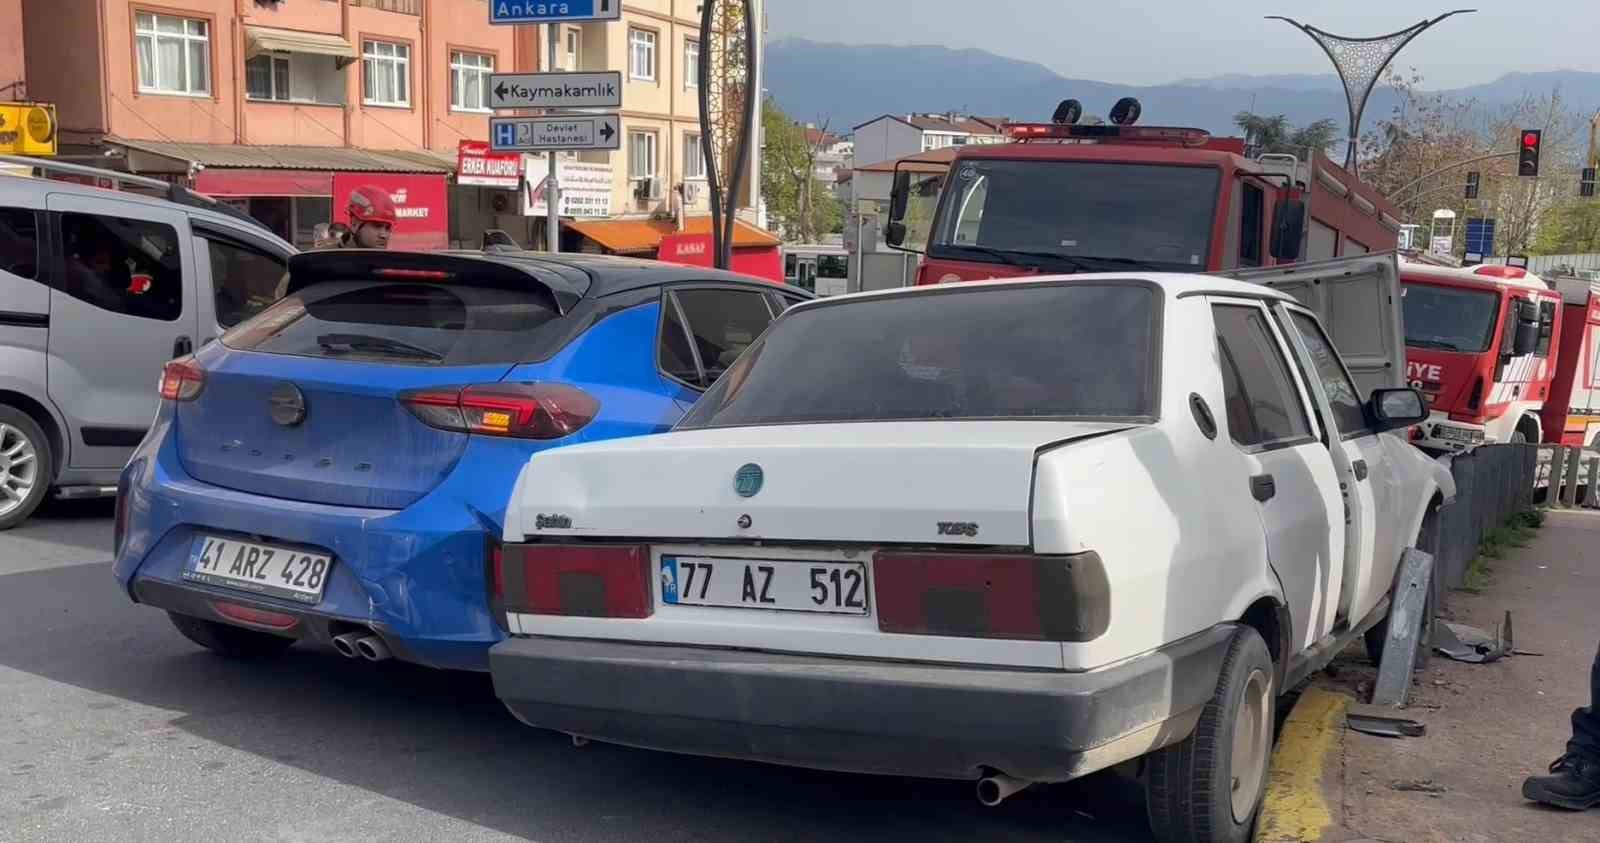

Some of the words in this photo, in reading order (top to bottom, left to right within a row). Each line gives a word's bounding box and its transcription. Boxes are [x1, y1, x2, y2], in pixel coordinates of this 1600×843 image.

[498, 0, 569, 16] Ankara
[511, 83, 616, 101] Kaymakamlık
[496, 124, 513, 145] H
[547, 123, 577, 132] Devlet
[539, 134, 588, 143] Hastanesi
[462, 157, 482, 174] ERKEK
[1407, 361, 1442, 380] İYE
[200, 540, 225, 571] 41
[228, 545, 275, 580] ARZ
[280, 553, 327, 589] 428
[680, 562, 713, 600] 77
[742, 564, 776, 603] AZ
[810, 567, 864, 608] 512
